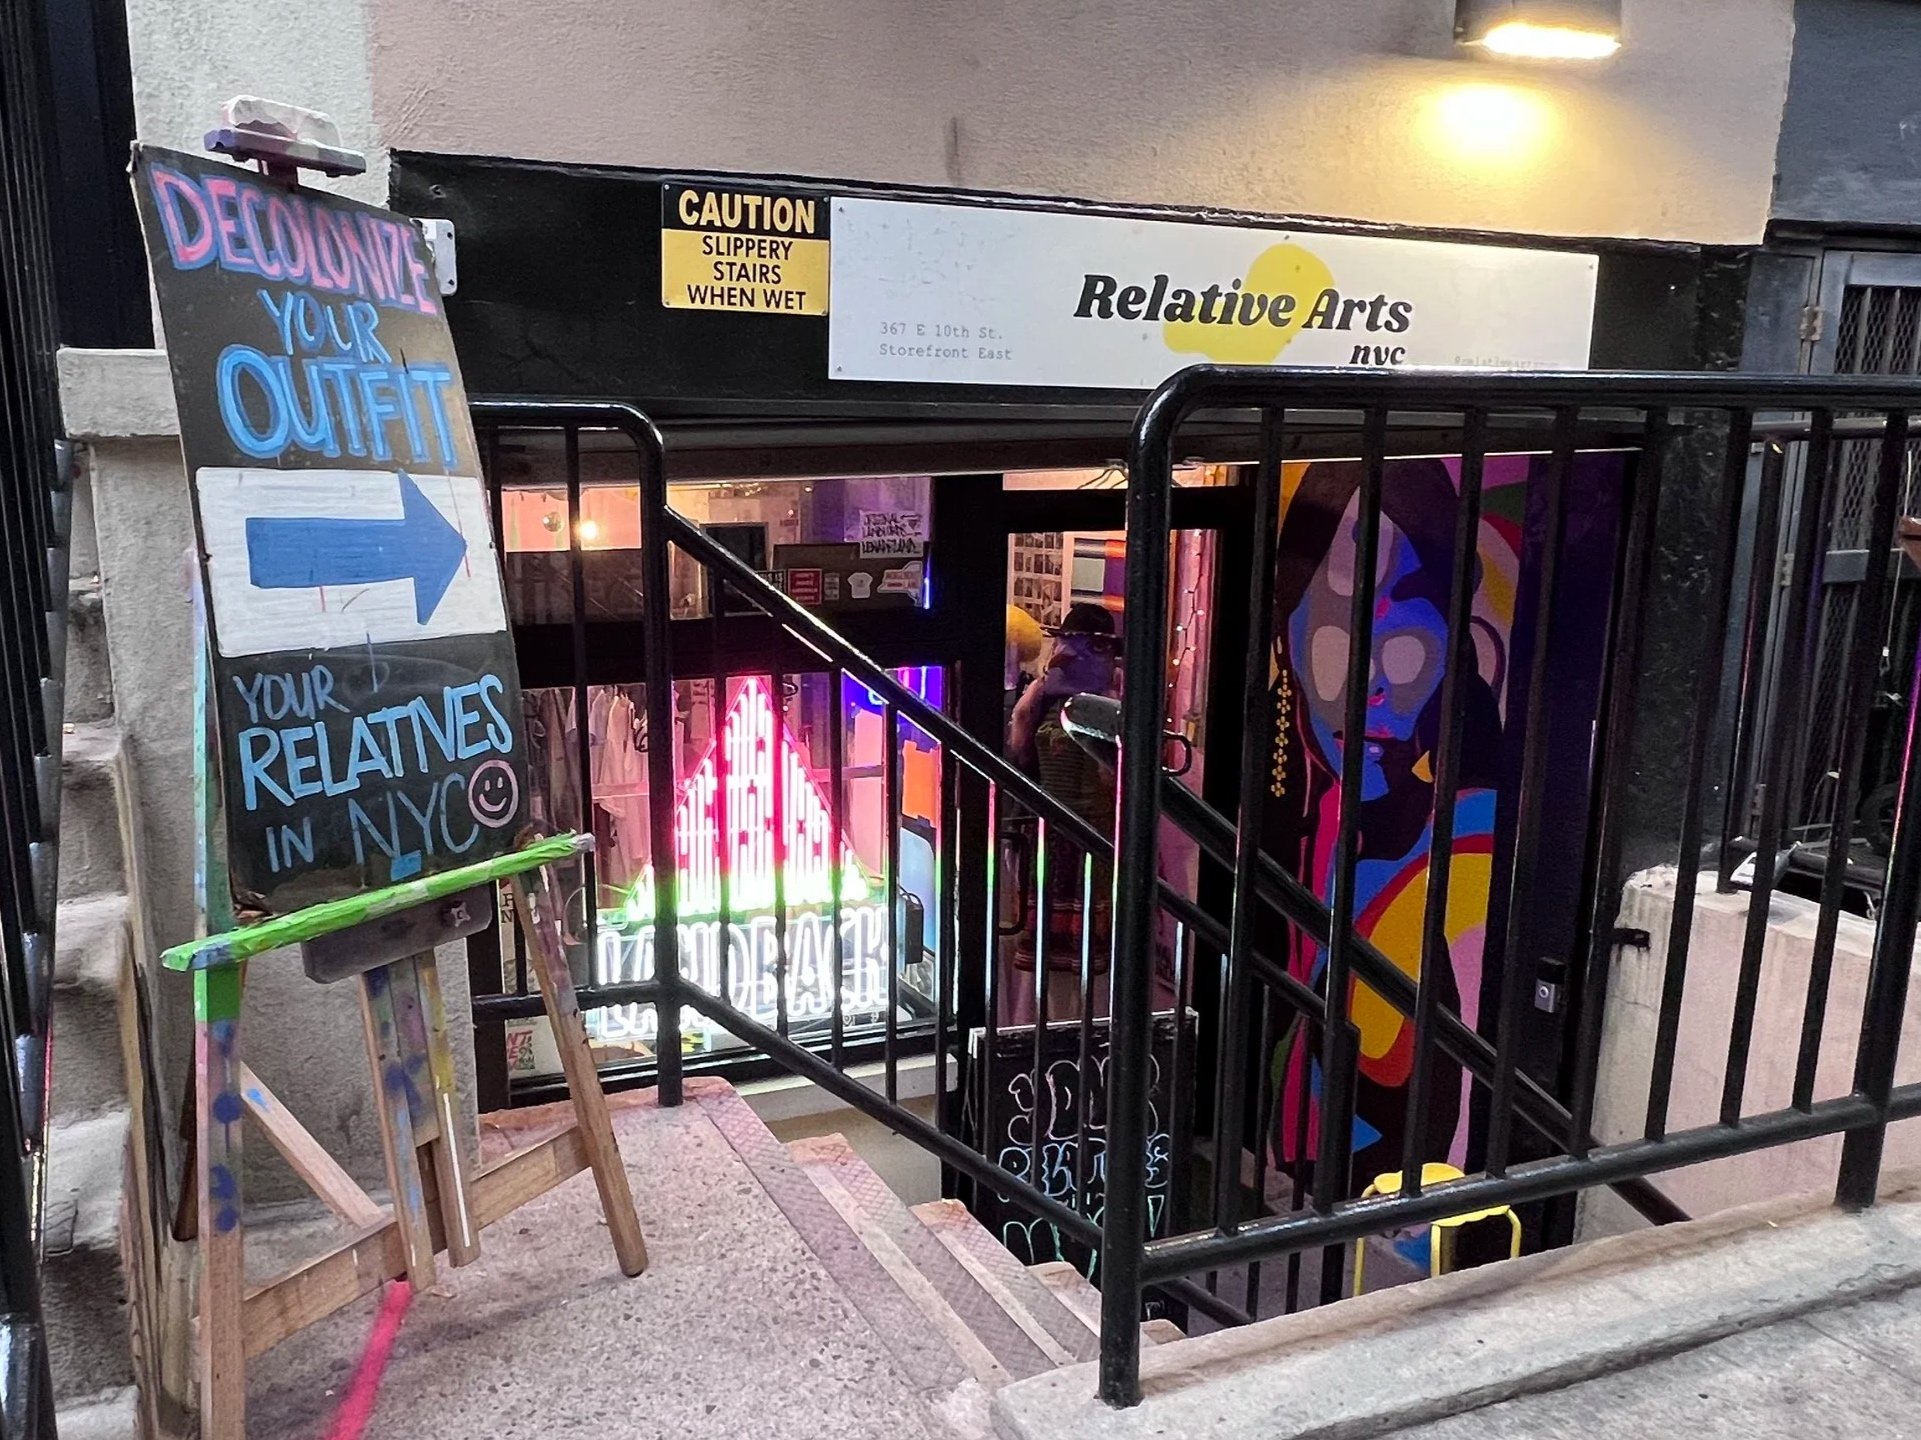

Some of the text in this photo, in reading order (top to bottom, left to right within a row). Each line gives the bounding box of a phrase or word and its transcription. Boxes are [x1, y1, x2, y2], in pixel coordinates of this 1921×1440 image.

[679, 189, 815, 233] CAUTION
[149, 163, 437, 315] DECOLONIZE
[702, 235, 793, 261] SLIPPERY
[687, 284, 806, 310] WHEN WET
[713, 261, 781, 284] STAIRS
[257, 288, 392, 364] YOUR
[1073, 274, 1412, 333] Relative Arts
[879, 343, 1013, 360] Storefront East
[880, 321, 1003, 339] 367 E 10th St.
[216, 344, 457, 470] OUTFIT
[233, 665, 350, 723] YOUR
[265, 772, 479, 873] IN NYC
